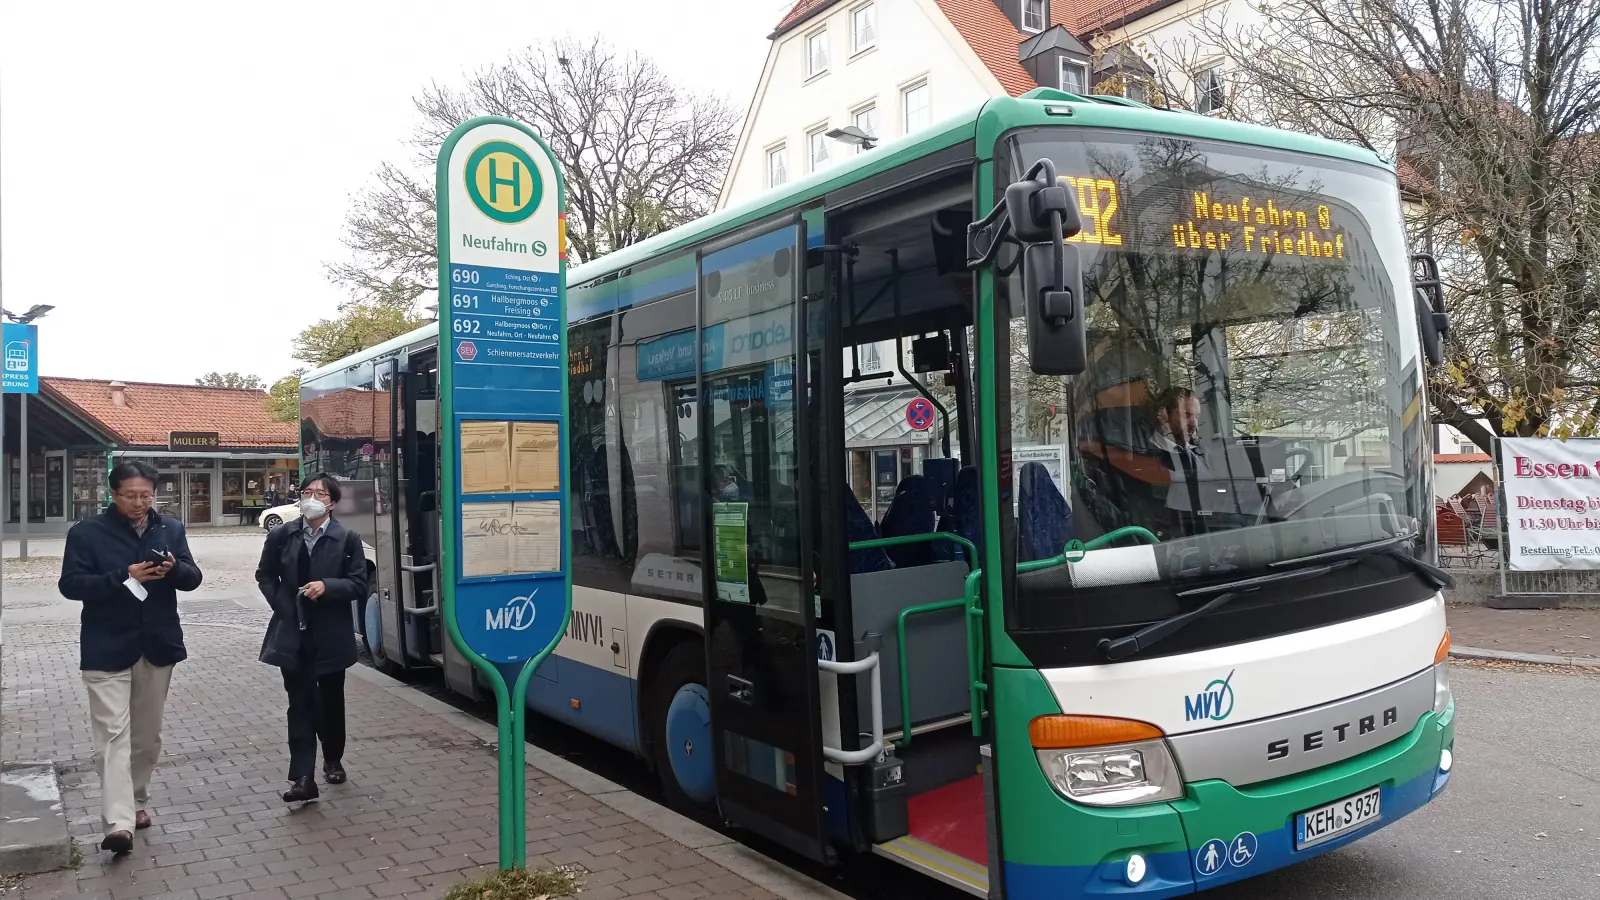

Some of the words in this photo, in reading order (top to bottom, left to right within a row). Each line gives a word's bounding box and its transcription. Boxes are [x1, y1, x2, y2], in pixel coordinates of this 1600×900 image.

[488, 157, 521, 207] H
[1056, 175, 1122, 246] 92
[1193, 191, 1307, 228] Neufahrn
[462, 233, 528, 254] Neufahrn
[1172, 220, 1231, 250] über
[1243, 226, 1344, 259] Friedhof
[452, 269, 480, 284] 690
[505, 273, 521, 282] Eching,
[485, 281, 508, 291] Garching,
[508, 284, 551, 294] Forschungszentrum
[746, 279, 776, 297] business
[452, 294, 479, 309] 691
[491, 294, 539, 306] Hallbergmoos
[504, 306, 531, 317] Freising
[453, 319, 481, 334] 692
[494, 320, 530, 330] Hallbergmoos
[486, 330, 514, 339] Neufahrn,
[527, 333, 551, 341] Neufahrn
[460, 346, 474, 355] SEV
[486, 348, 560, 360] Schienenersatzverkehr
[2, 380, 29, 388] ERUNG
[173, 436, 208, 446] MÜLLER
[1514, 456, 1591, 478] Essen
[1516, 495, 1586, 514] Dienstag
[1519, 517, 1554, 530] 11.30
[1557, 517, 1584, 530] Uhr
[1071, 540, 1078, 551] 4
[1520, 546, 1572, 558] Bestellung
[647, 568, 695, 583] SETRA
[485, 588, 539, 631] MVV
[571, 610, 604, 648] MVV!
[1184, 669, 1235, 721] MVV
[1267, 706, 1398, 761] SETRA
[1306, 807, 1335, 839] KEH
[1344, 801, 1353, 825] S
[1355, 791, 1380, 820] 937
